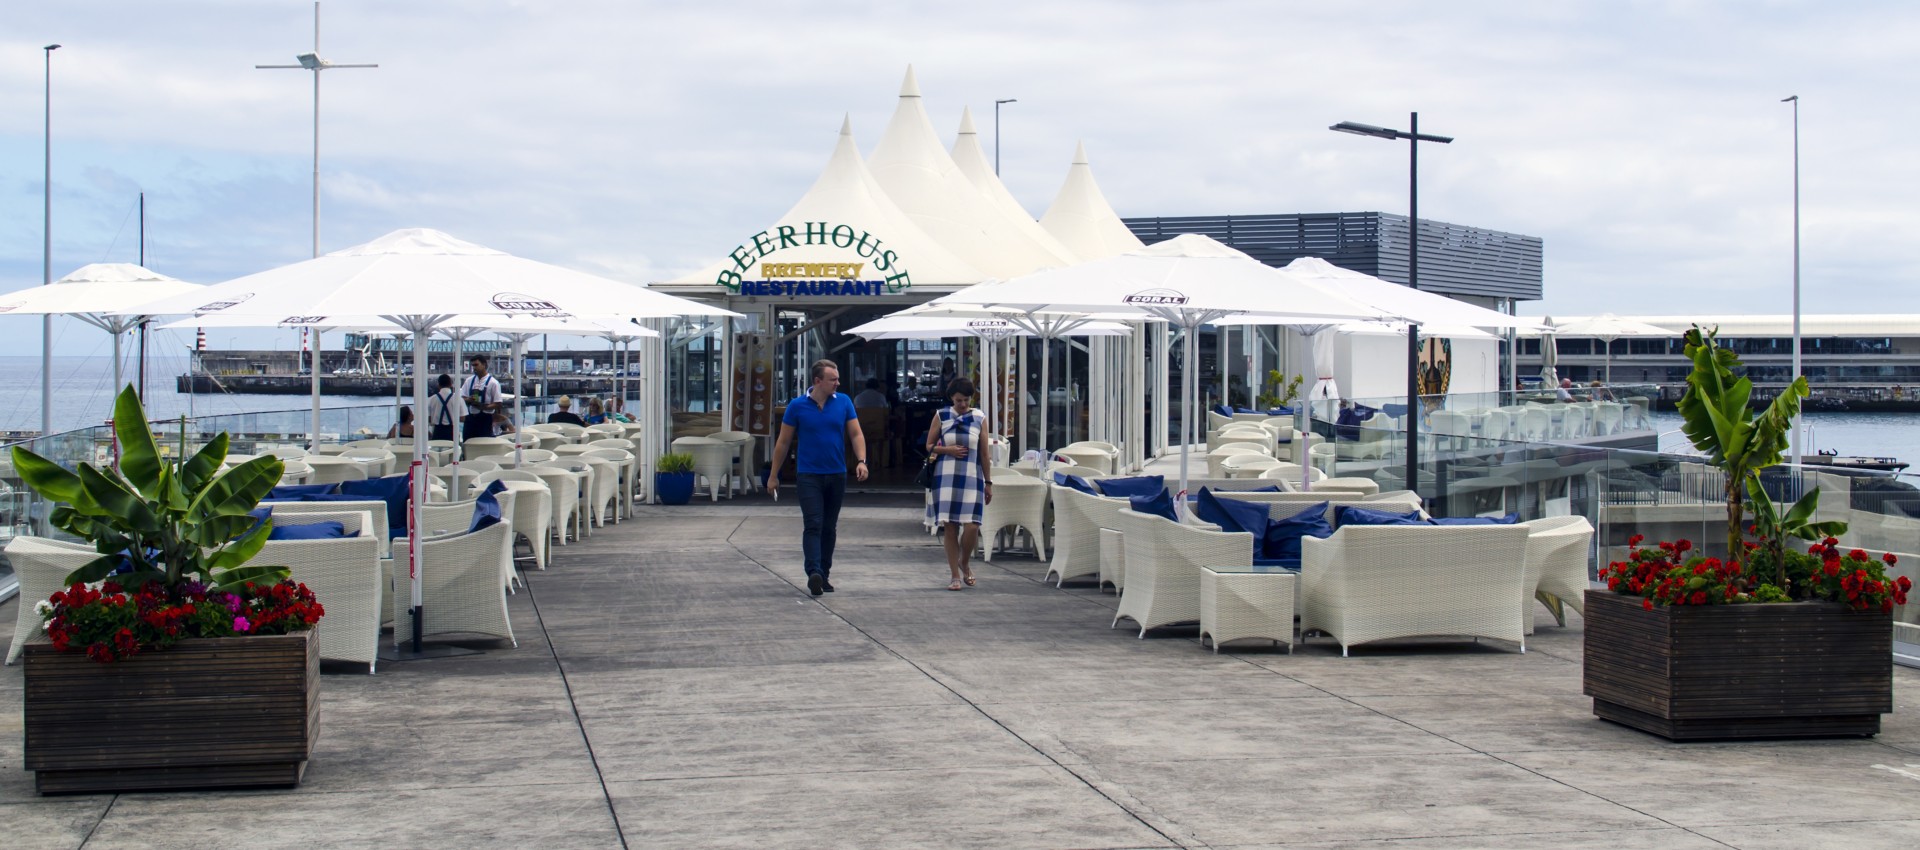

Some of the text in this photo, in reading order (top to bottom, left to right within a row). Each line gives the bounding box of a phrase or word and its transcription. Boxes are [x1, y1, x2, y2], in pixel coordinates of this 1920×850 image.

[716, 221, 911, 293] BEERHOUSE
[761, 263, 865, 279] BREWERY
[741, 280, 885, 296] RESTAURANT
[498, 301, 554, 310] CORAL
[1131, 295, 1182, 305] CORAL
